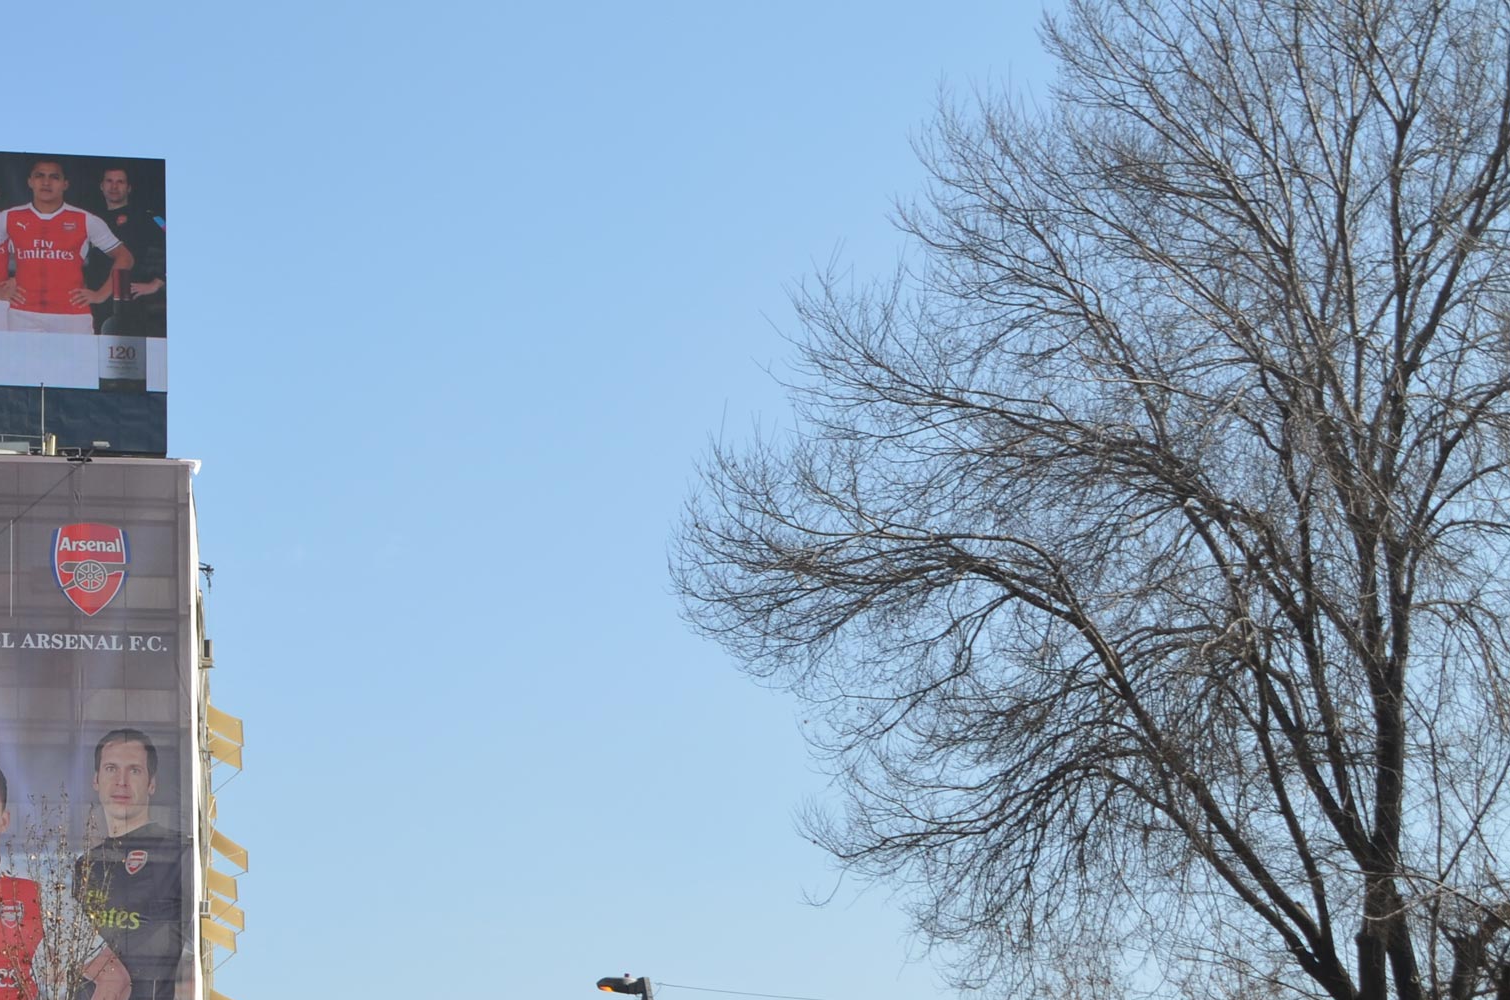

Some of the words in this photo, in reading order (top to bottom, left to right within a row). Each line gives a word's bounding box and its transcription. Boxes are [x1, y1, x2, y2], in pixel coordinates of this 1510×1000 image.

[33, 239, 54, 249] Fly
[17, 247, 74, 261] Emirates
[108, 345, 136, 360] 120
[59, 536, 121, 553] Arsenal
[21, 632, 124, 651] ARSENAL
[129, 635, 168, 652] F.C.
